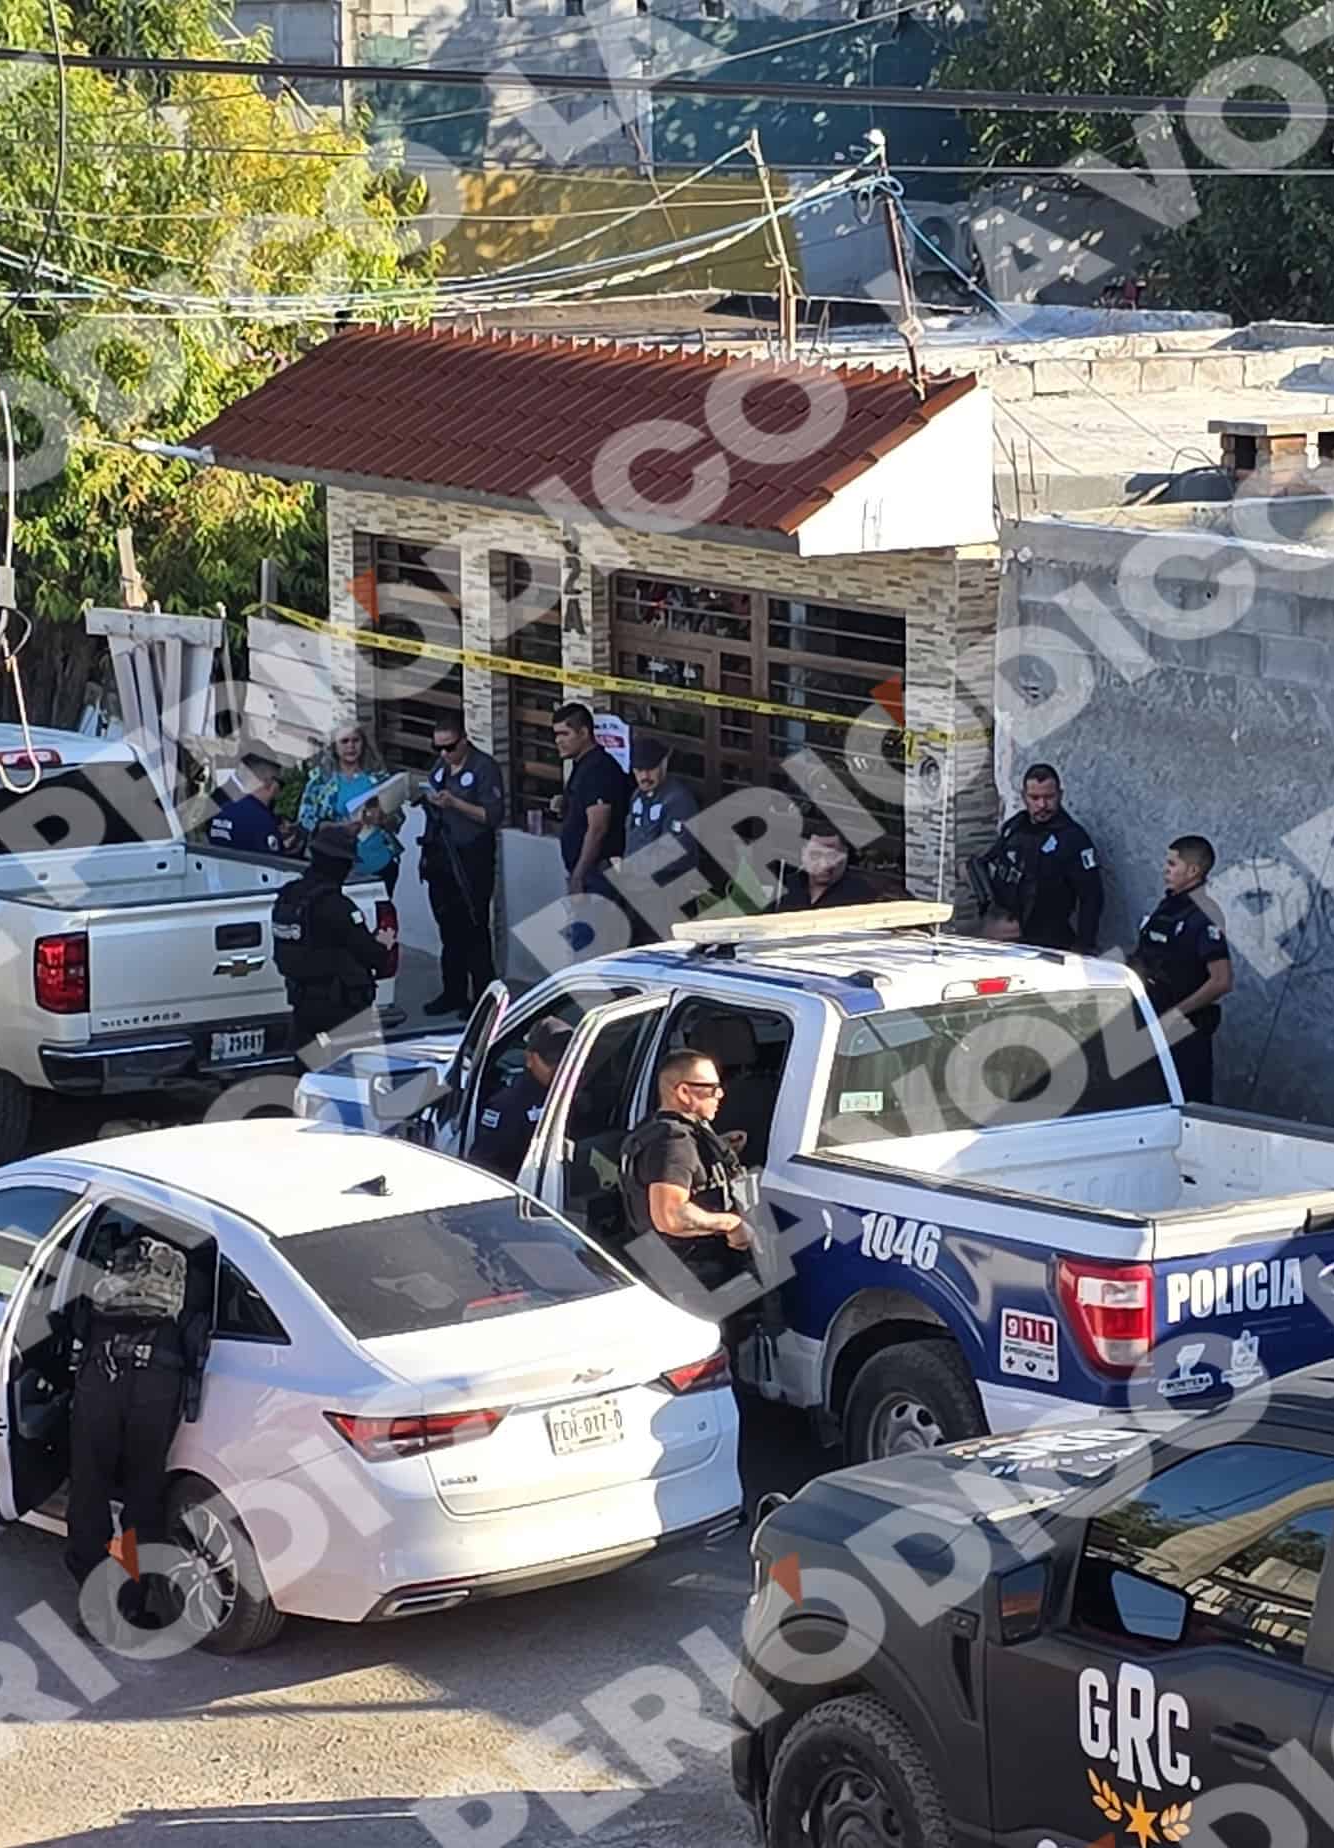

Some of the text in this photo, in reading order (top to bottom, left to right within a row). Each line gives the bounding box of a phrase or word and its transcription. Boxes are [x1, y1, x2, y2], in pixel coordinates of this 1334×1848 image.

[861, 1212, 941, 1271] 1046
[1166, 1258, 1304, 1324] POLICIA
[1007, 1317, 1054, 1343] 911
